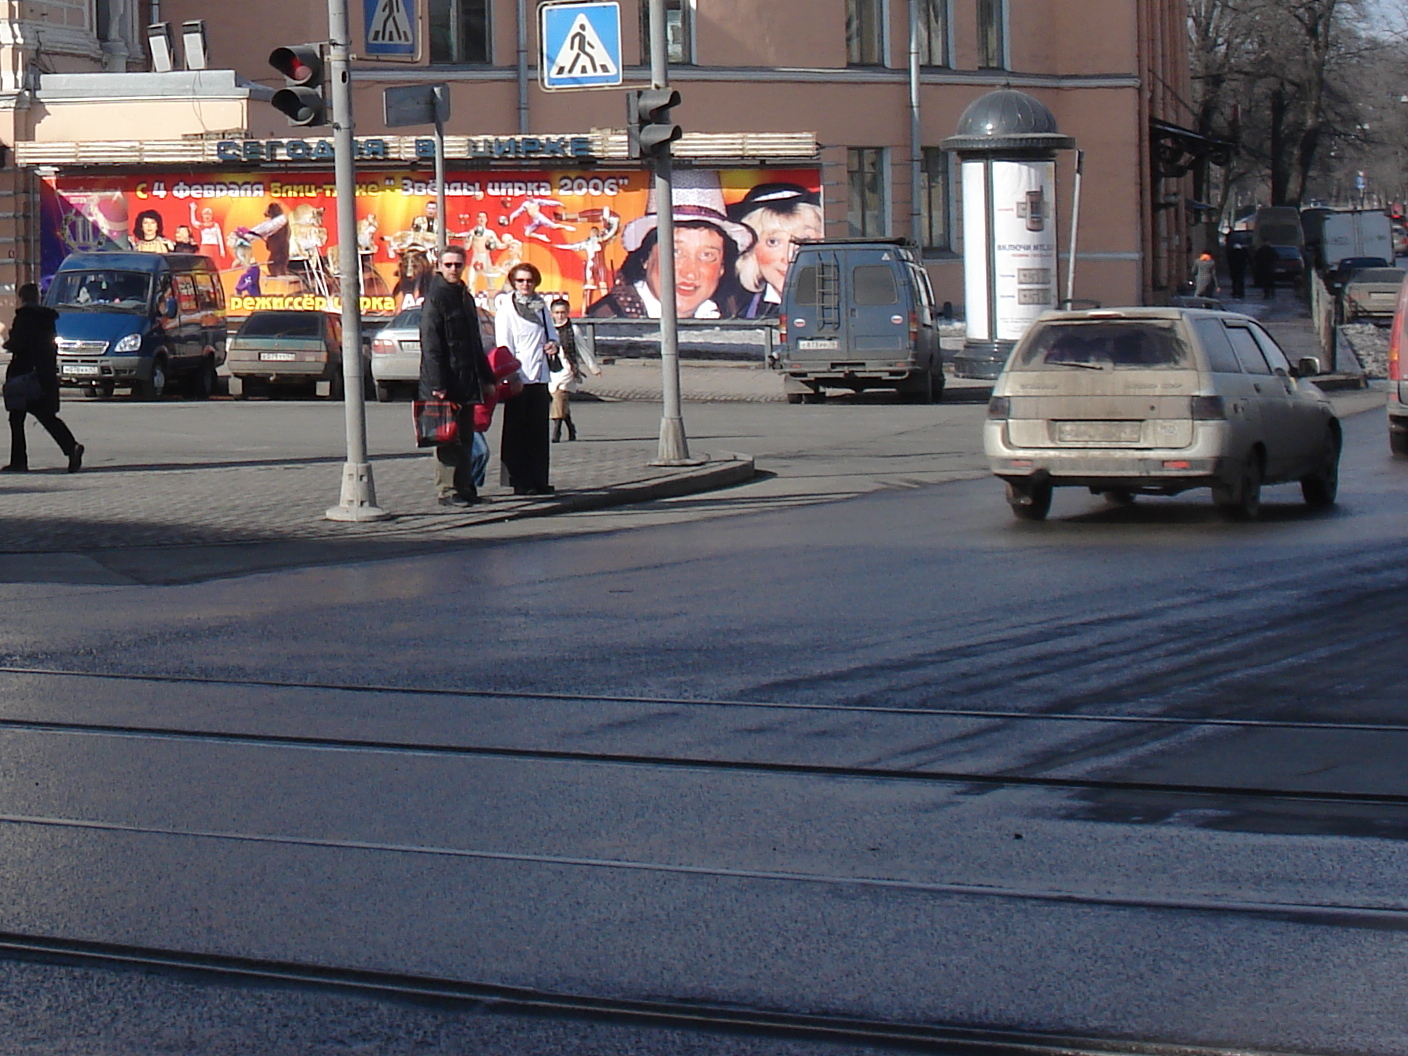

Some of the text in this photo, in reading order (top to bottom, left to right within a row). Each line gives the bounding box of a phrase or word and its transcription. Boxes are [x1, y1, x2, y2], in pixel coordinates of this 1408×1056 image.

[414, 138, 435, 158] В
[466, 137, 590, 157] ЦИРКЕ
[152, 182, 167, 199] 4
[172, 181, 265, 199] февраля
[486, 180, 551, 196] цирка
[230, 294, 327, 311] режиссёр
[333, 295, 396, 311] црка
